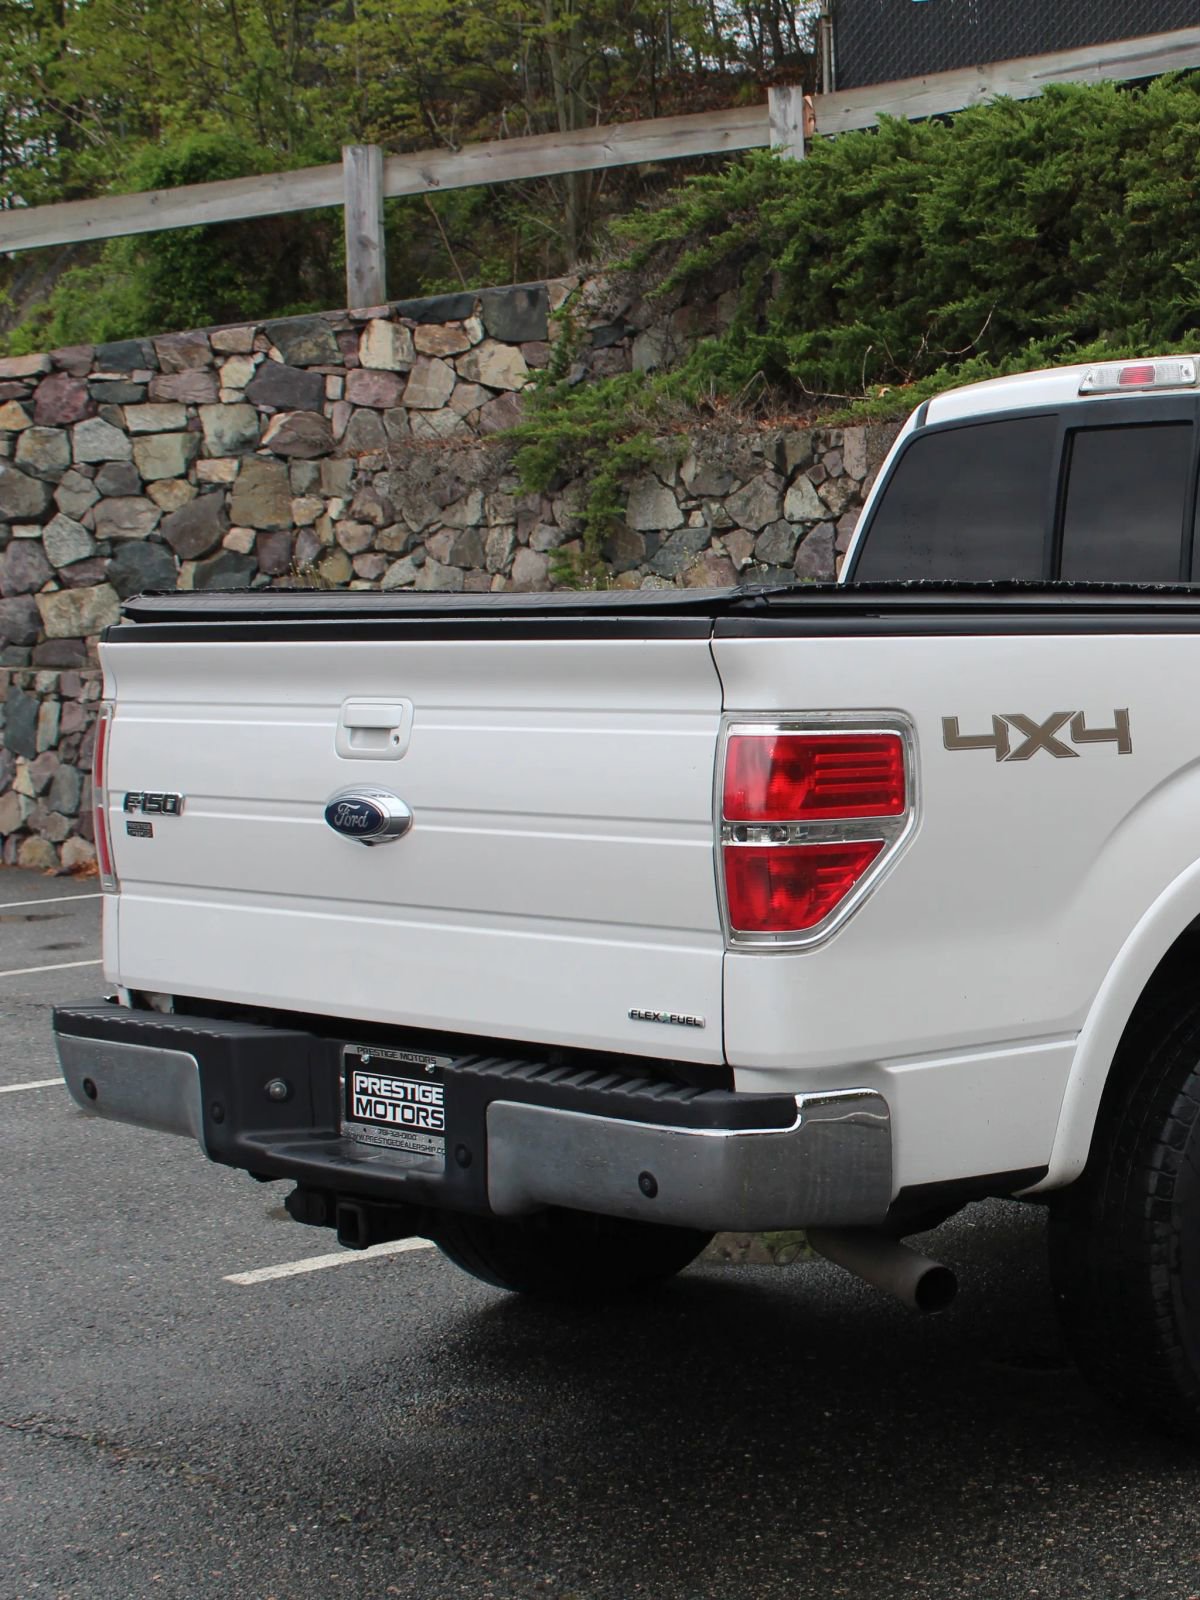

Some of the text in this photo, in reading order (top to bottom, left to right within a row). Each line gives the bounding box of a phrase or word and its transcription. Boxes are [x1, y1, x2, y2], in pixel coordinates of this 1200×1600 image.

[942, 708, 1132, 762] 4X4
[334, 802, 369, 828] Ford
[630, 1009, 701, 1027] FLEX FUEL
[356, 1046, 437, 1065] PRESTIGE MOTORS
[355, 1075, 444, 1105] PRESTIGE
[356, 1096, 444, 1129] MOTORS
